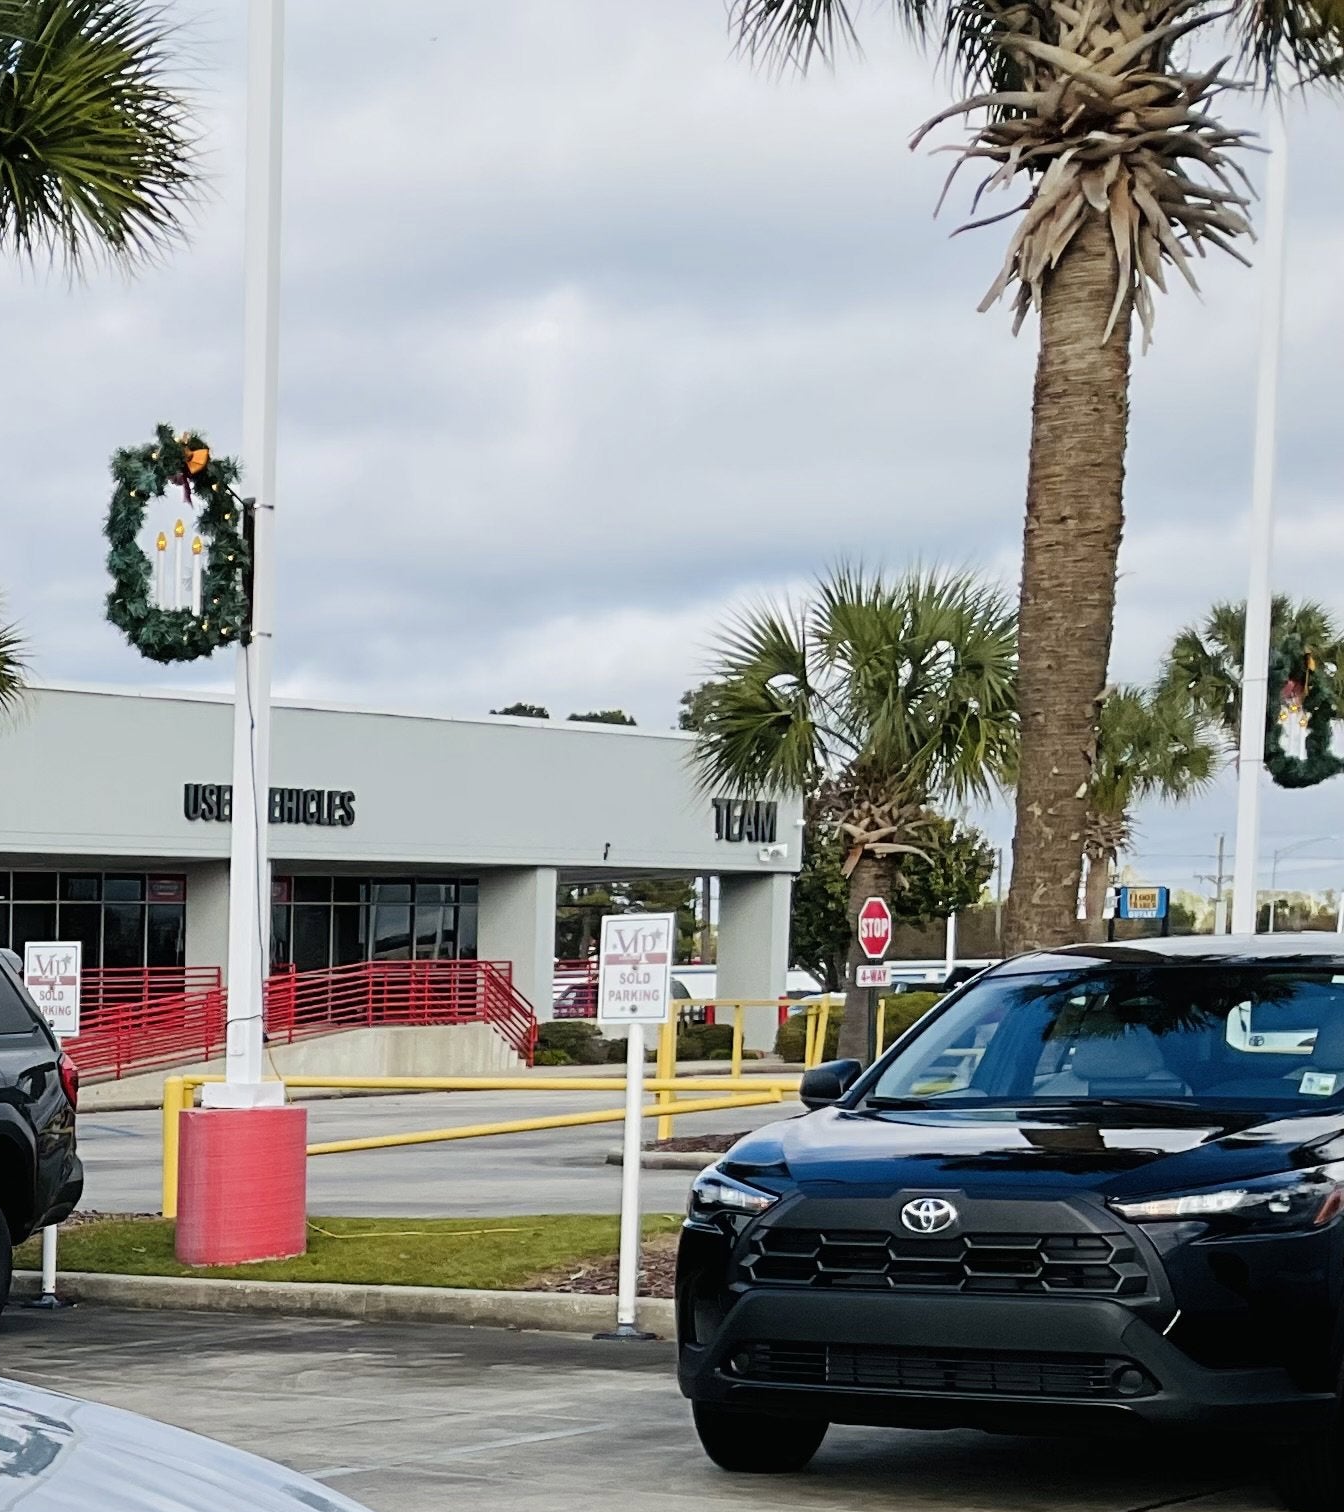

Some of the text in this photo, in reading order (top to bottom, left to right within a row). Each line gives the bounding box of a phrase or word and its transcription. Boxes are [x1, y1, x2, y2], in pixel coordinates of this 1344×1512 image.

[184, 783, 356, 826] USE EHICLES
[712, 797, 778, 843] TEAM
[861, 917, 889, 938] STOP
[619, 972, 651, 985] SOLD
[861, 969, 887, 982] 4-WAY
[40, 991, 65, 1001] SOLD
[608, 989, 661, 1002] PARKING
[39, 1005, 72, 1016] RKING
